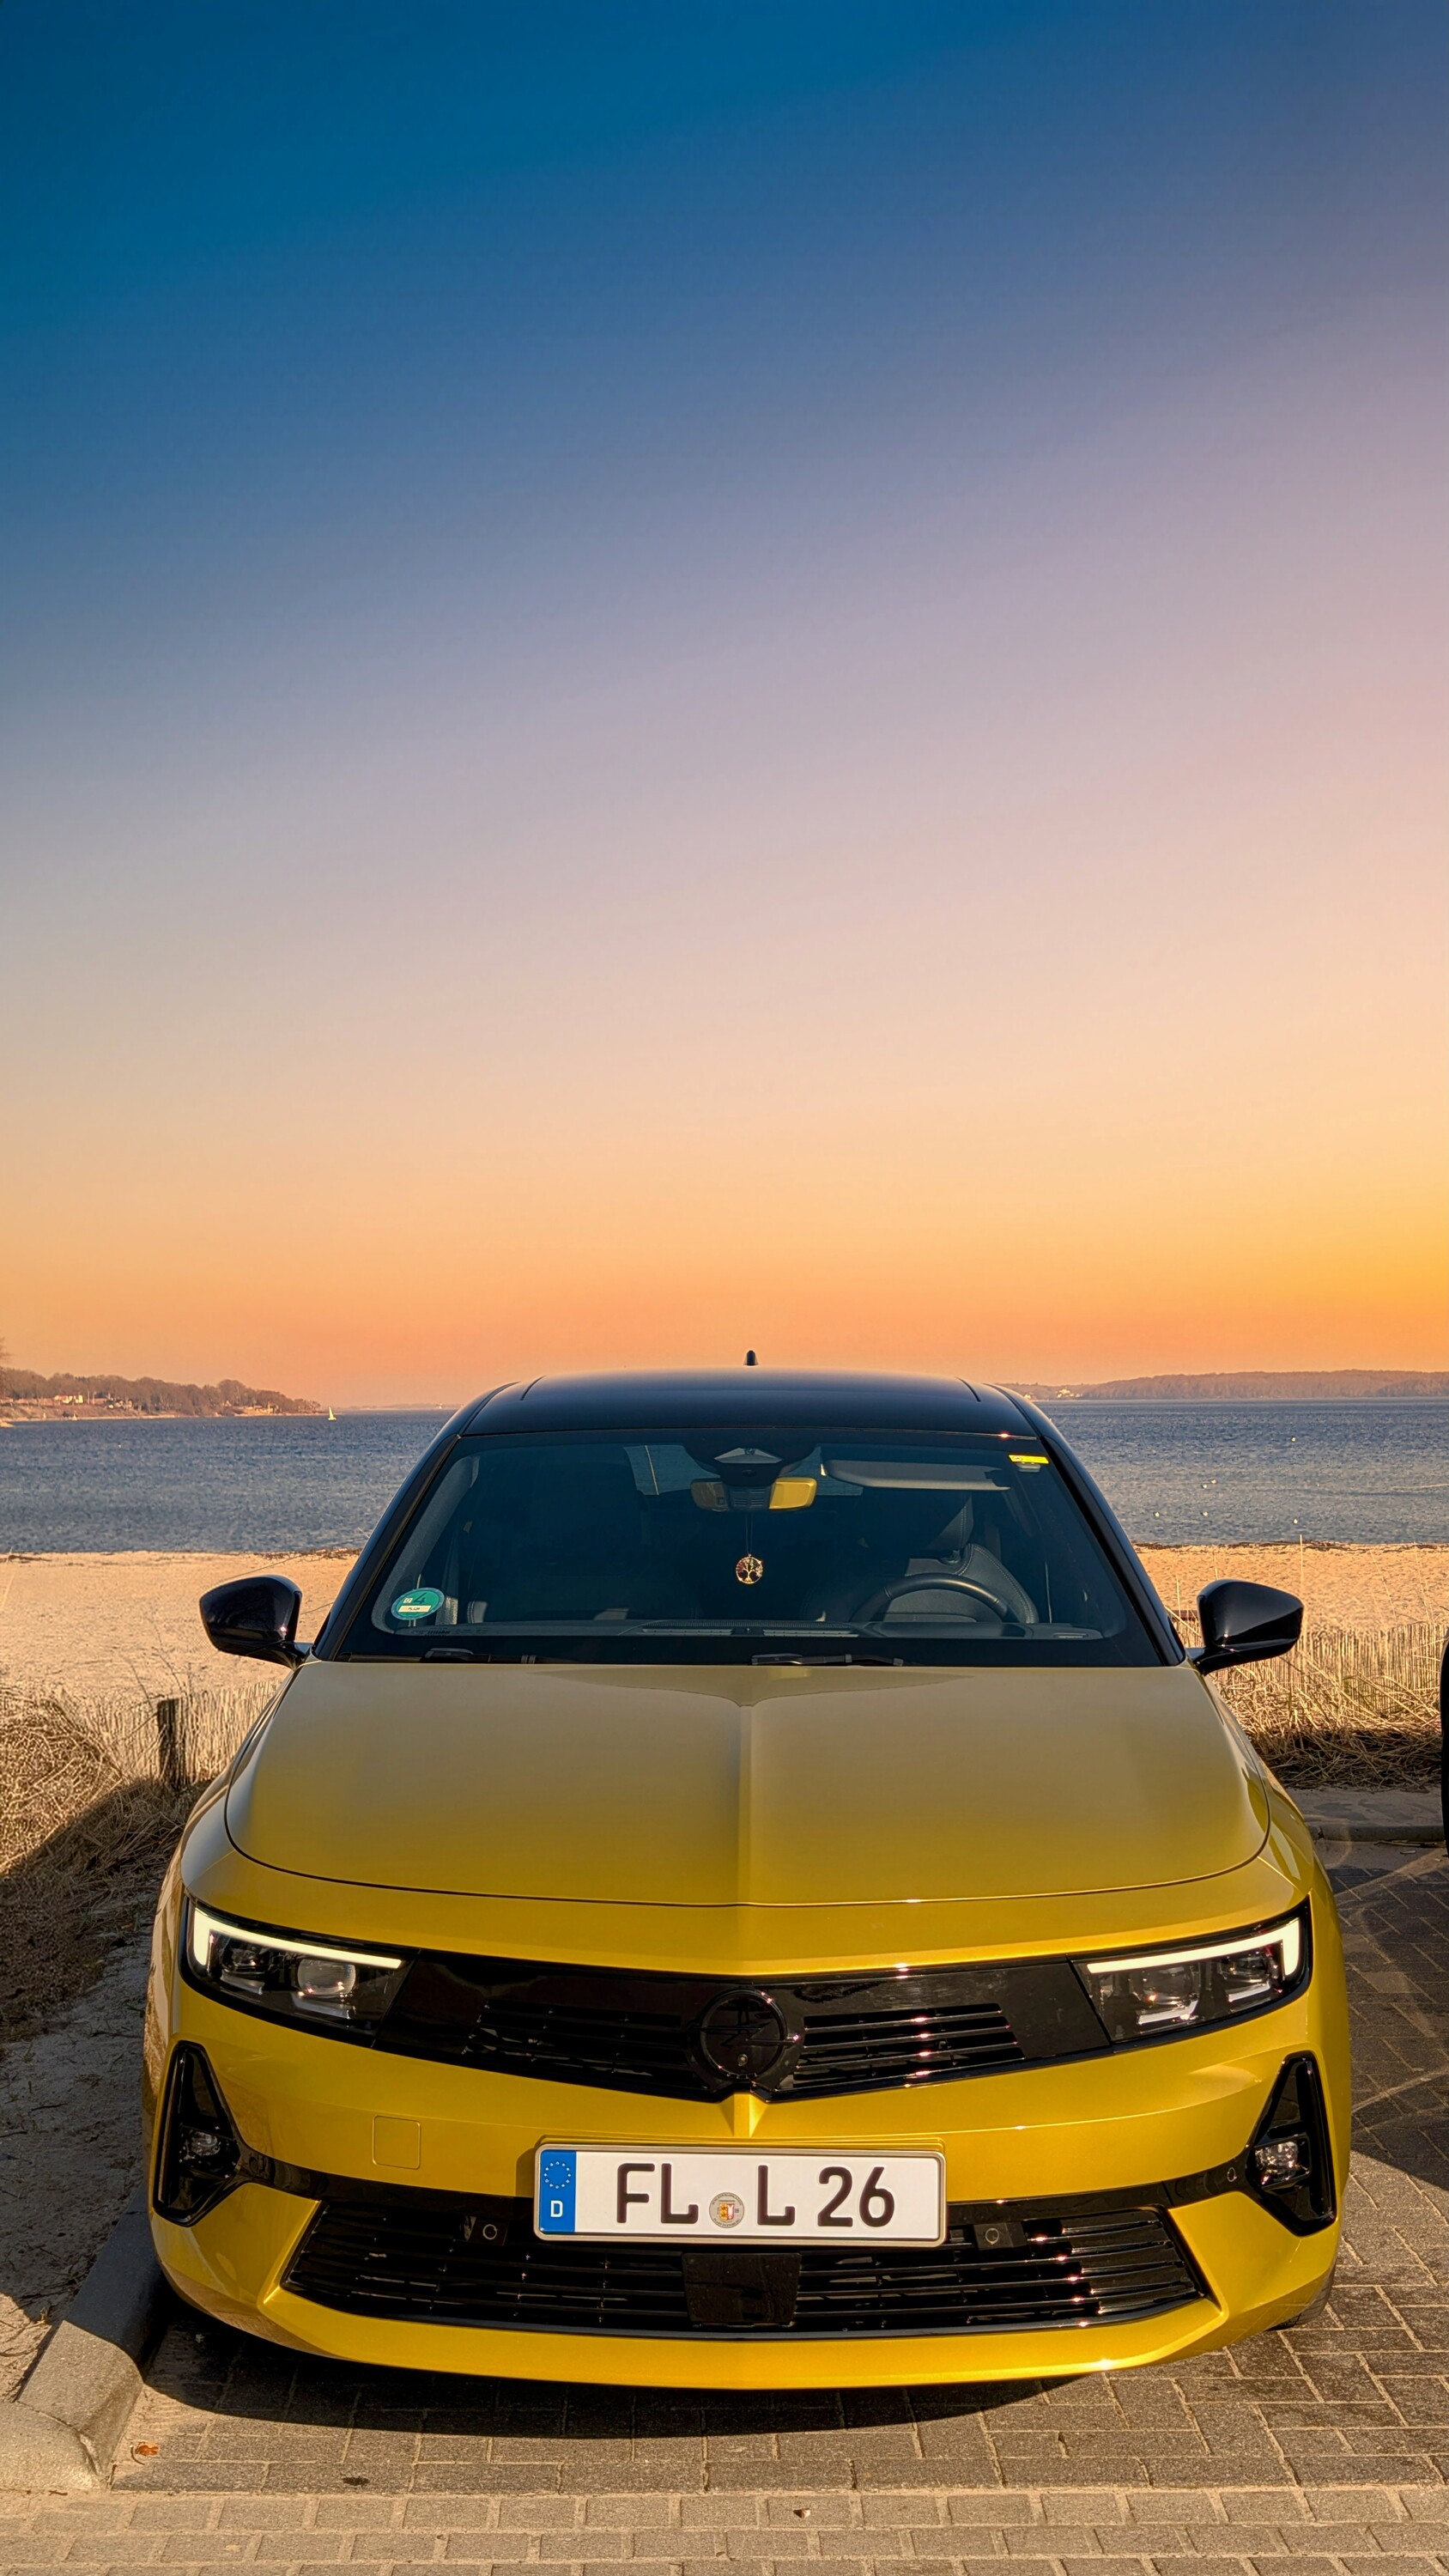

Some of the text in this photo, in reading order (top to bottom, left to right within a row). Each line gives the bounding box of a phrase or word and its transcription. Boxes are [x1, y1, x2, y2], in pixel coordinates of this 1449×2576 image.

[414, 1593, 427, 1604] 4
[616, 2163, 895, 2227] FL L 26
[550, 2200, 563, 2218] D
